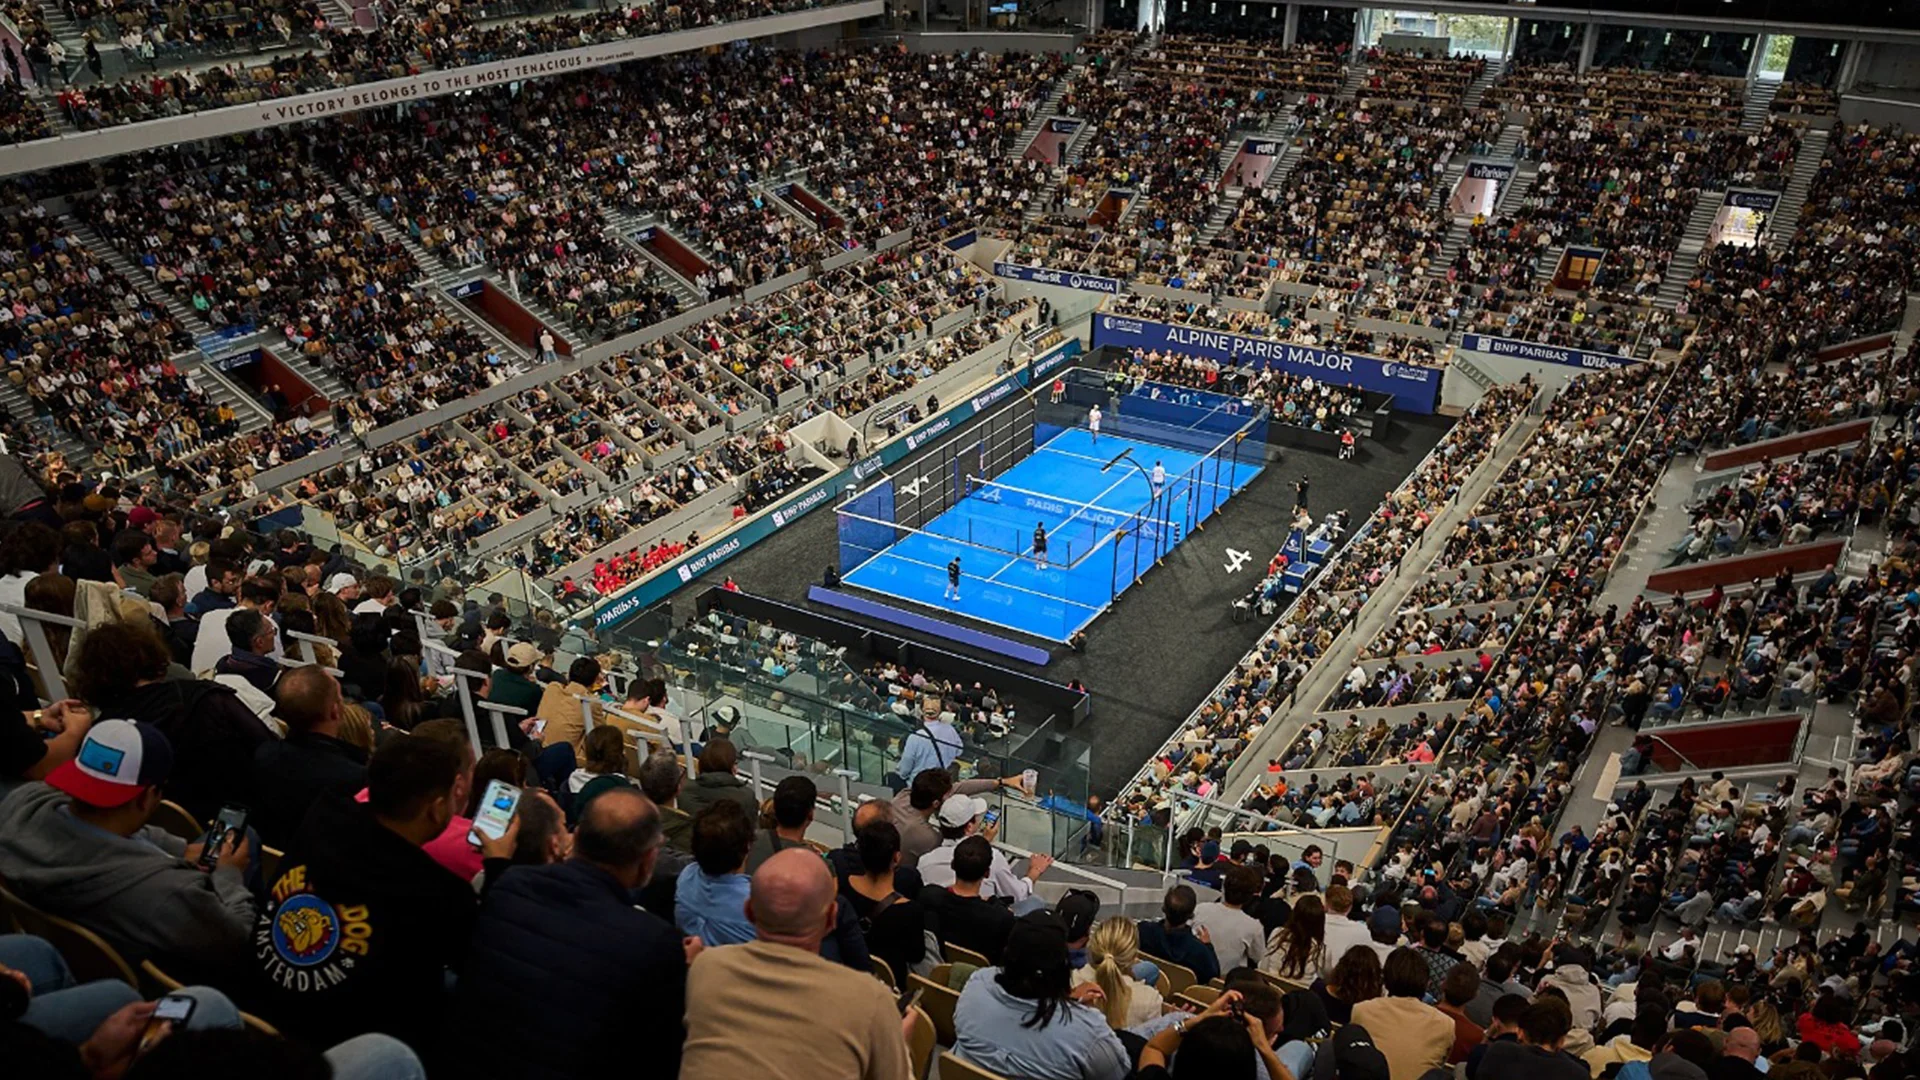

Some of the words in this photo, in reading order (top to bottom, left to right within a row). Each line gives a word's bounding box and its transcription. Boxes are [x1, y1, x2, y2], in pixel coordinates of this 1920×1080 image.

[276, 97, 345, 118] VICTORY
[352, 84, 418, 106] BELONGS
[423, 80, 440, 93] TO
[445, 74, 471, 88] THE
[476, 68, 510, 83] MOST
[515, 56, 582, 76] TENACIOUS
[1083, 279, 1115, 292] VEOLIA
[1166, 327, 1230, 351] ALPINE
[1233, 338, 1283, 360] PARIS
[1287, 347, 1353, 372] MAJOR
[1493, 341, 1518, 353] BNP
[1519, 345, 1569, 362] PARIBAS
[782, 504, 799, 520] BNP
[797, 488, 828, 511] PARIBAS
[1026, 497, 1064, 514] PARIS
[690, 557, 707, 573] BNP
[706, 537, 740, 563] PARIBAS
[272, 864, 307, 903] THE
[334, 903, 373, 956] DOG
[256, 914, 348, 992] AMSTERDAM
